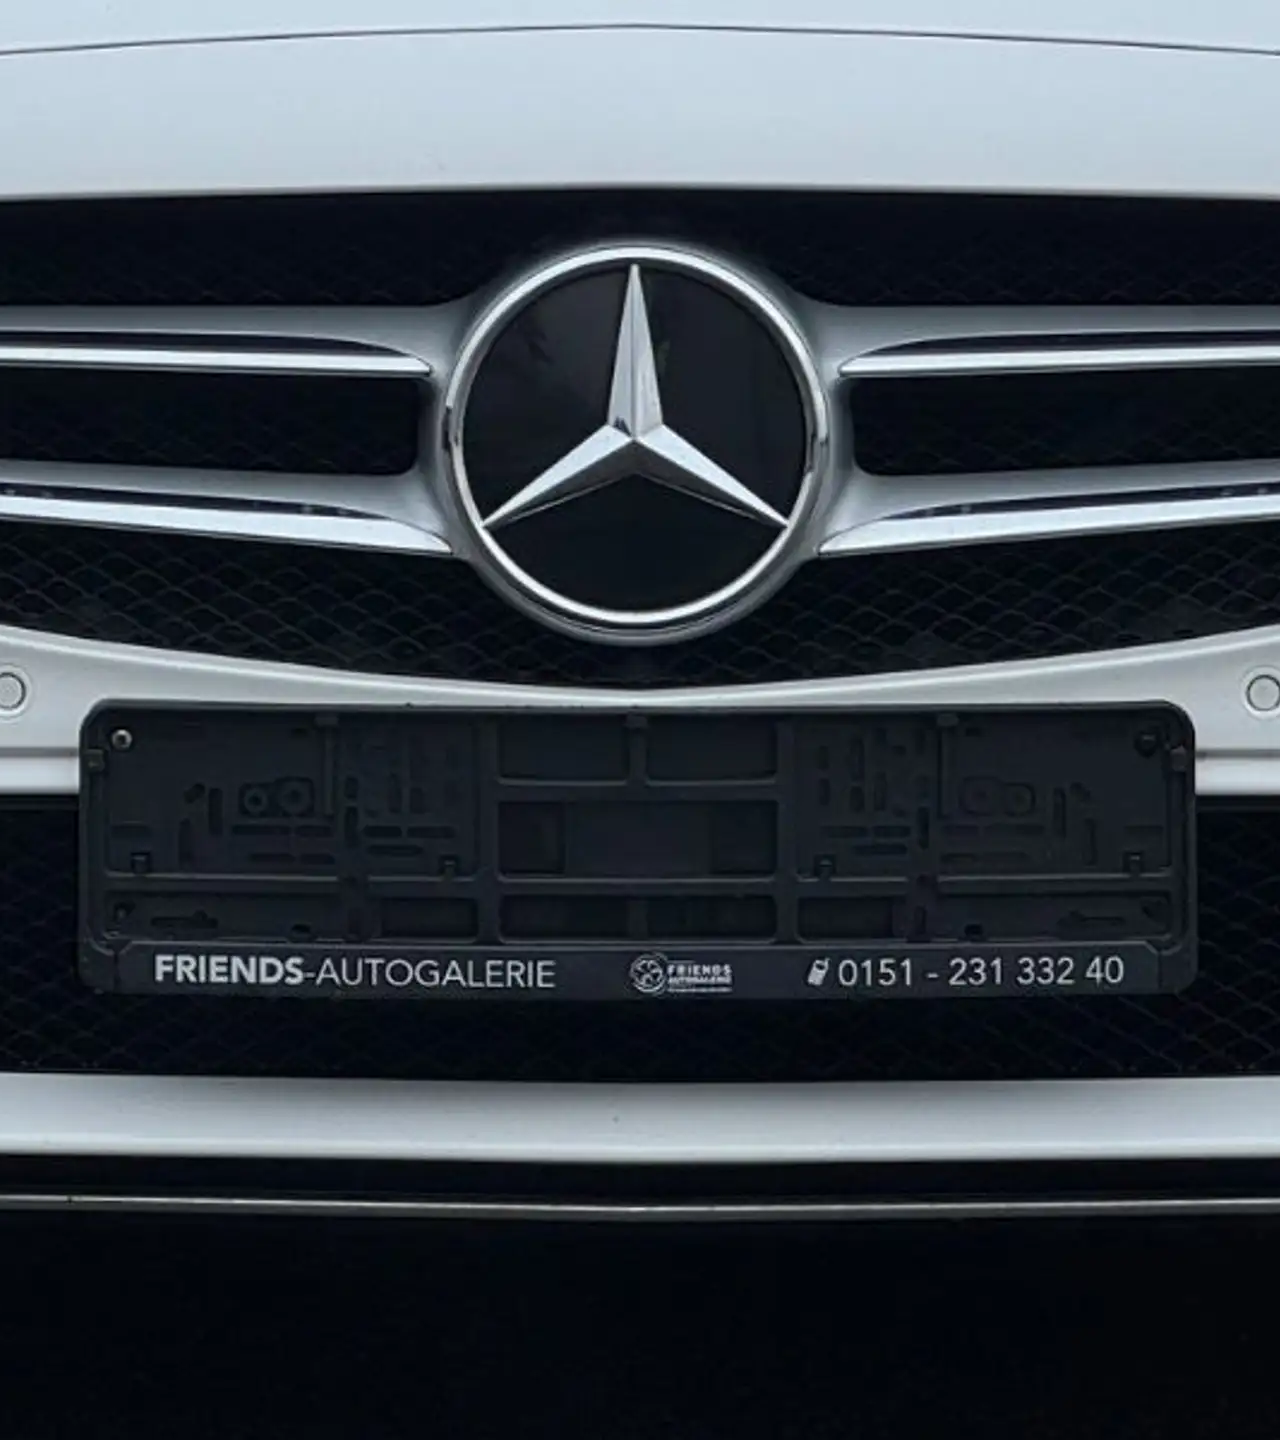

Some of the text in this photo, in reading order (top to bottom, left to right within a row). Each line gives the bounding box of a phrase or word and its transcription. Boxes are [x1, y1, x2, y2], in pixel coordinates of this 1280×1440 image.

[154, 953, 557, 988] FRIENDS-AUTOGALERIE
[667, 963, 732, 976] FRIENDS
[837, 957, 912, 987] 0151
[947, 956, 1002, 987] 231
[1015, 956, 1075, 986] 332
[1084, 955, 1125, 985] 40
